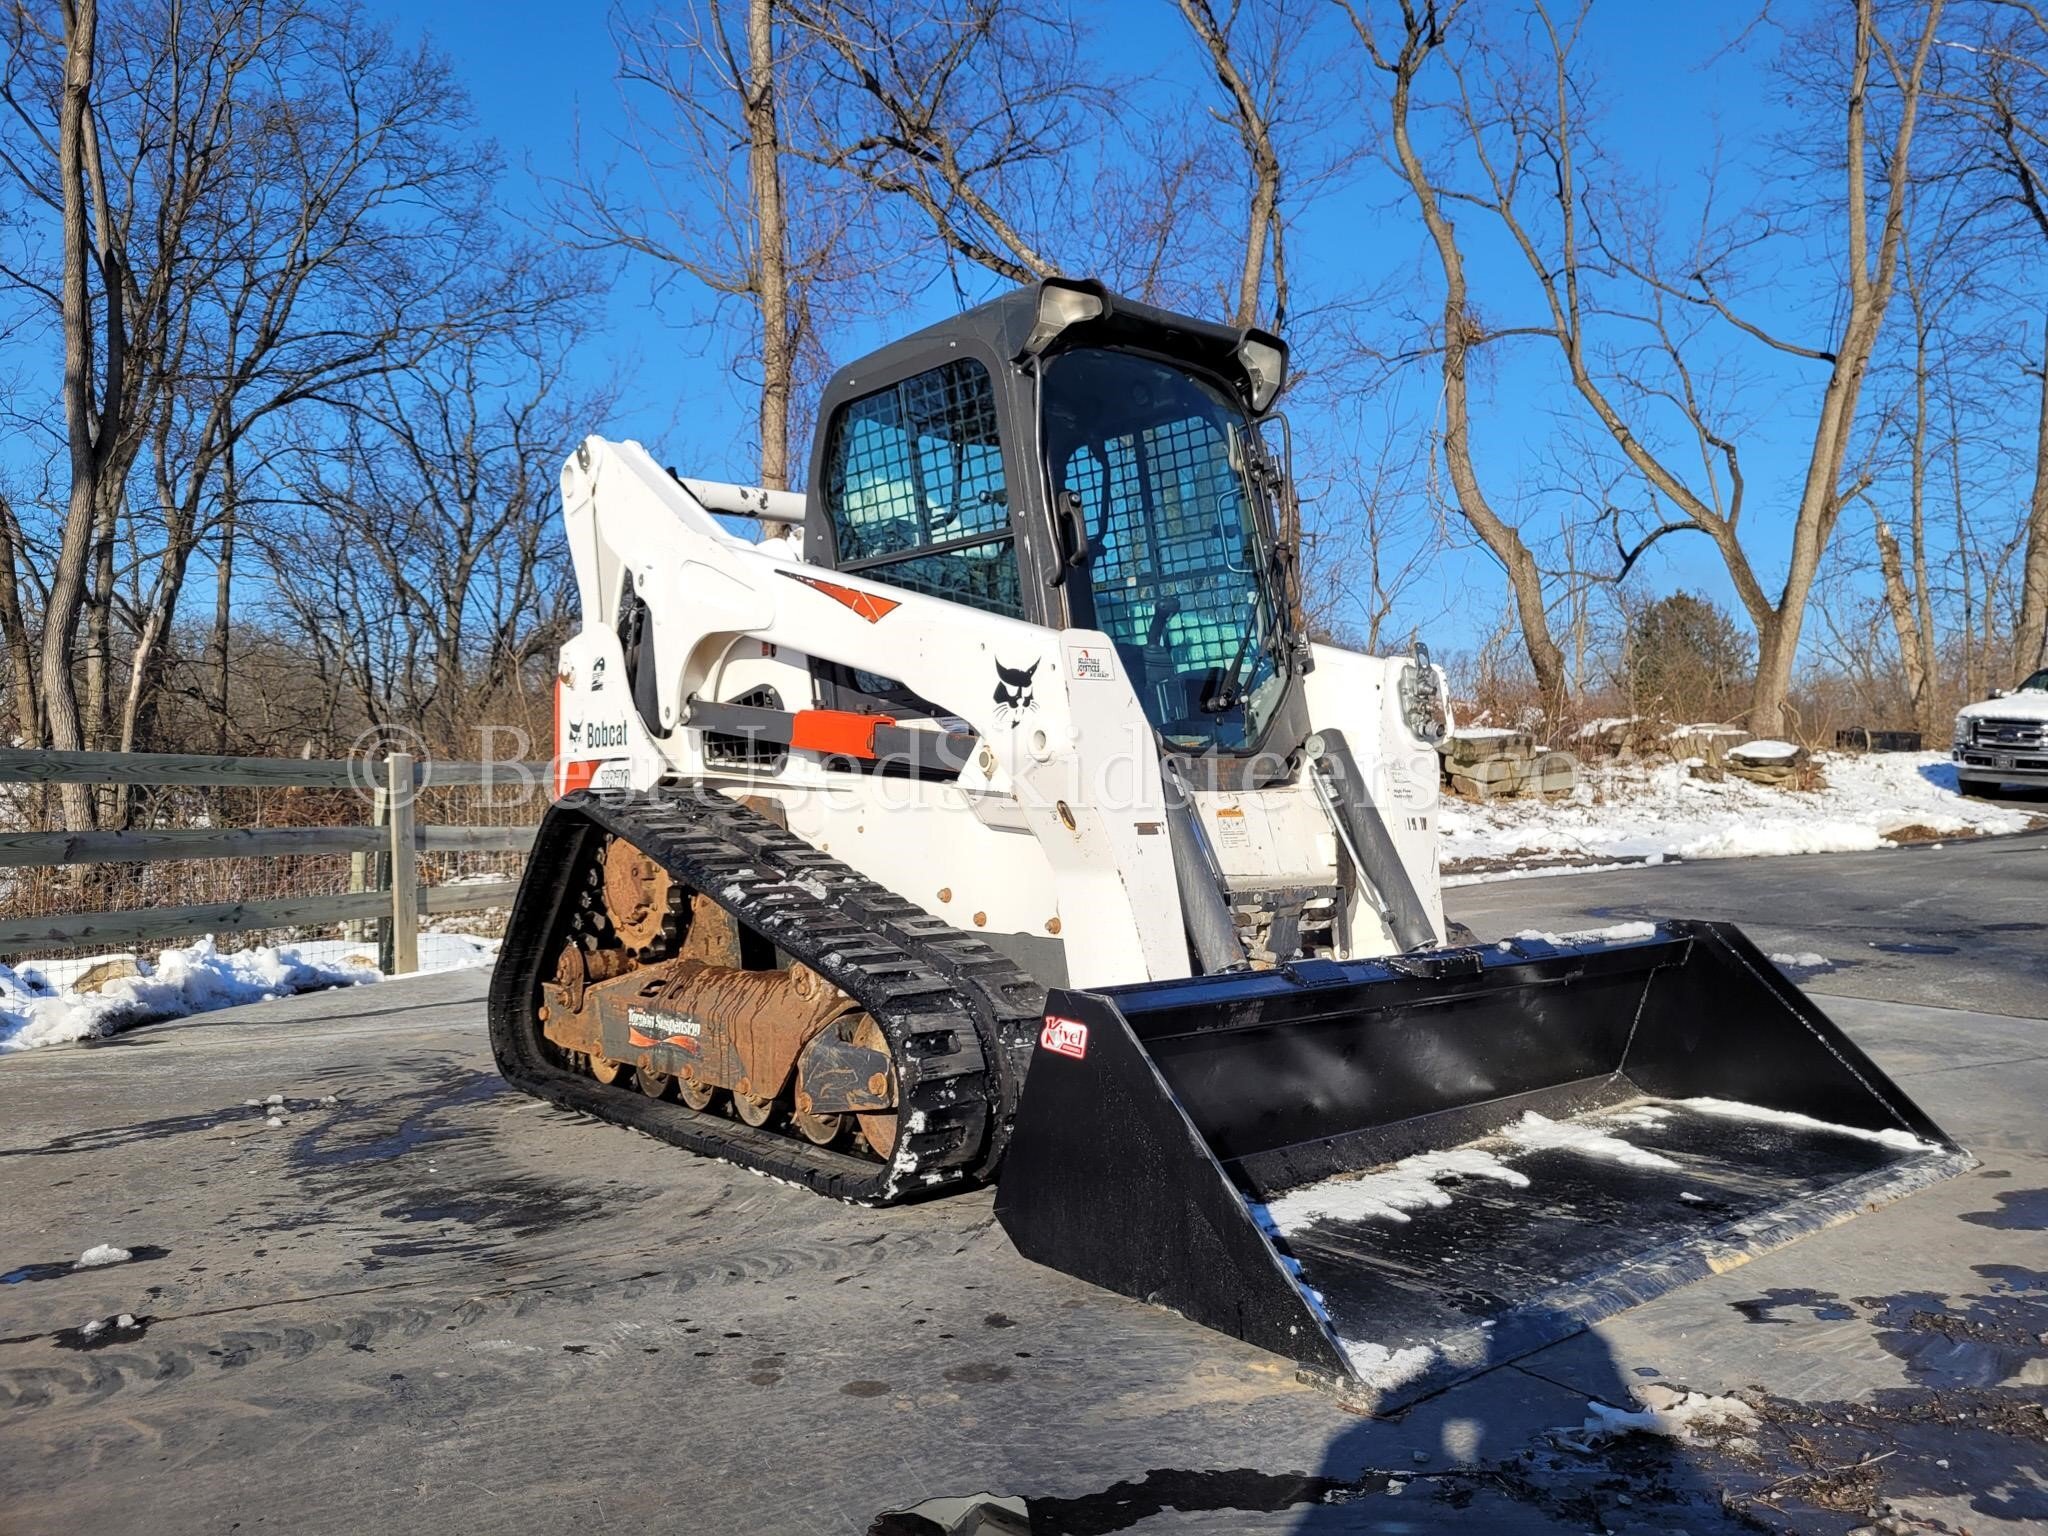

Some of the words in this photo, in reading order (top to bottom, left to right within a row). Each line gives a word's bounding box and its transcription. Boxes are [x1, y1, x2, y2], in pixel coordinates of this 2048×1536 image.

[587, 720, 628, 749] Bobcat
[655, 1013, 701, 1037] Suspension
[1046, 1018, 1084, 1047] Kivel
